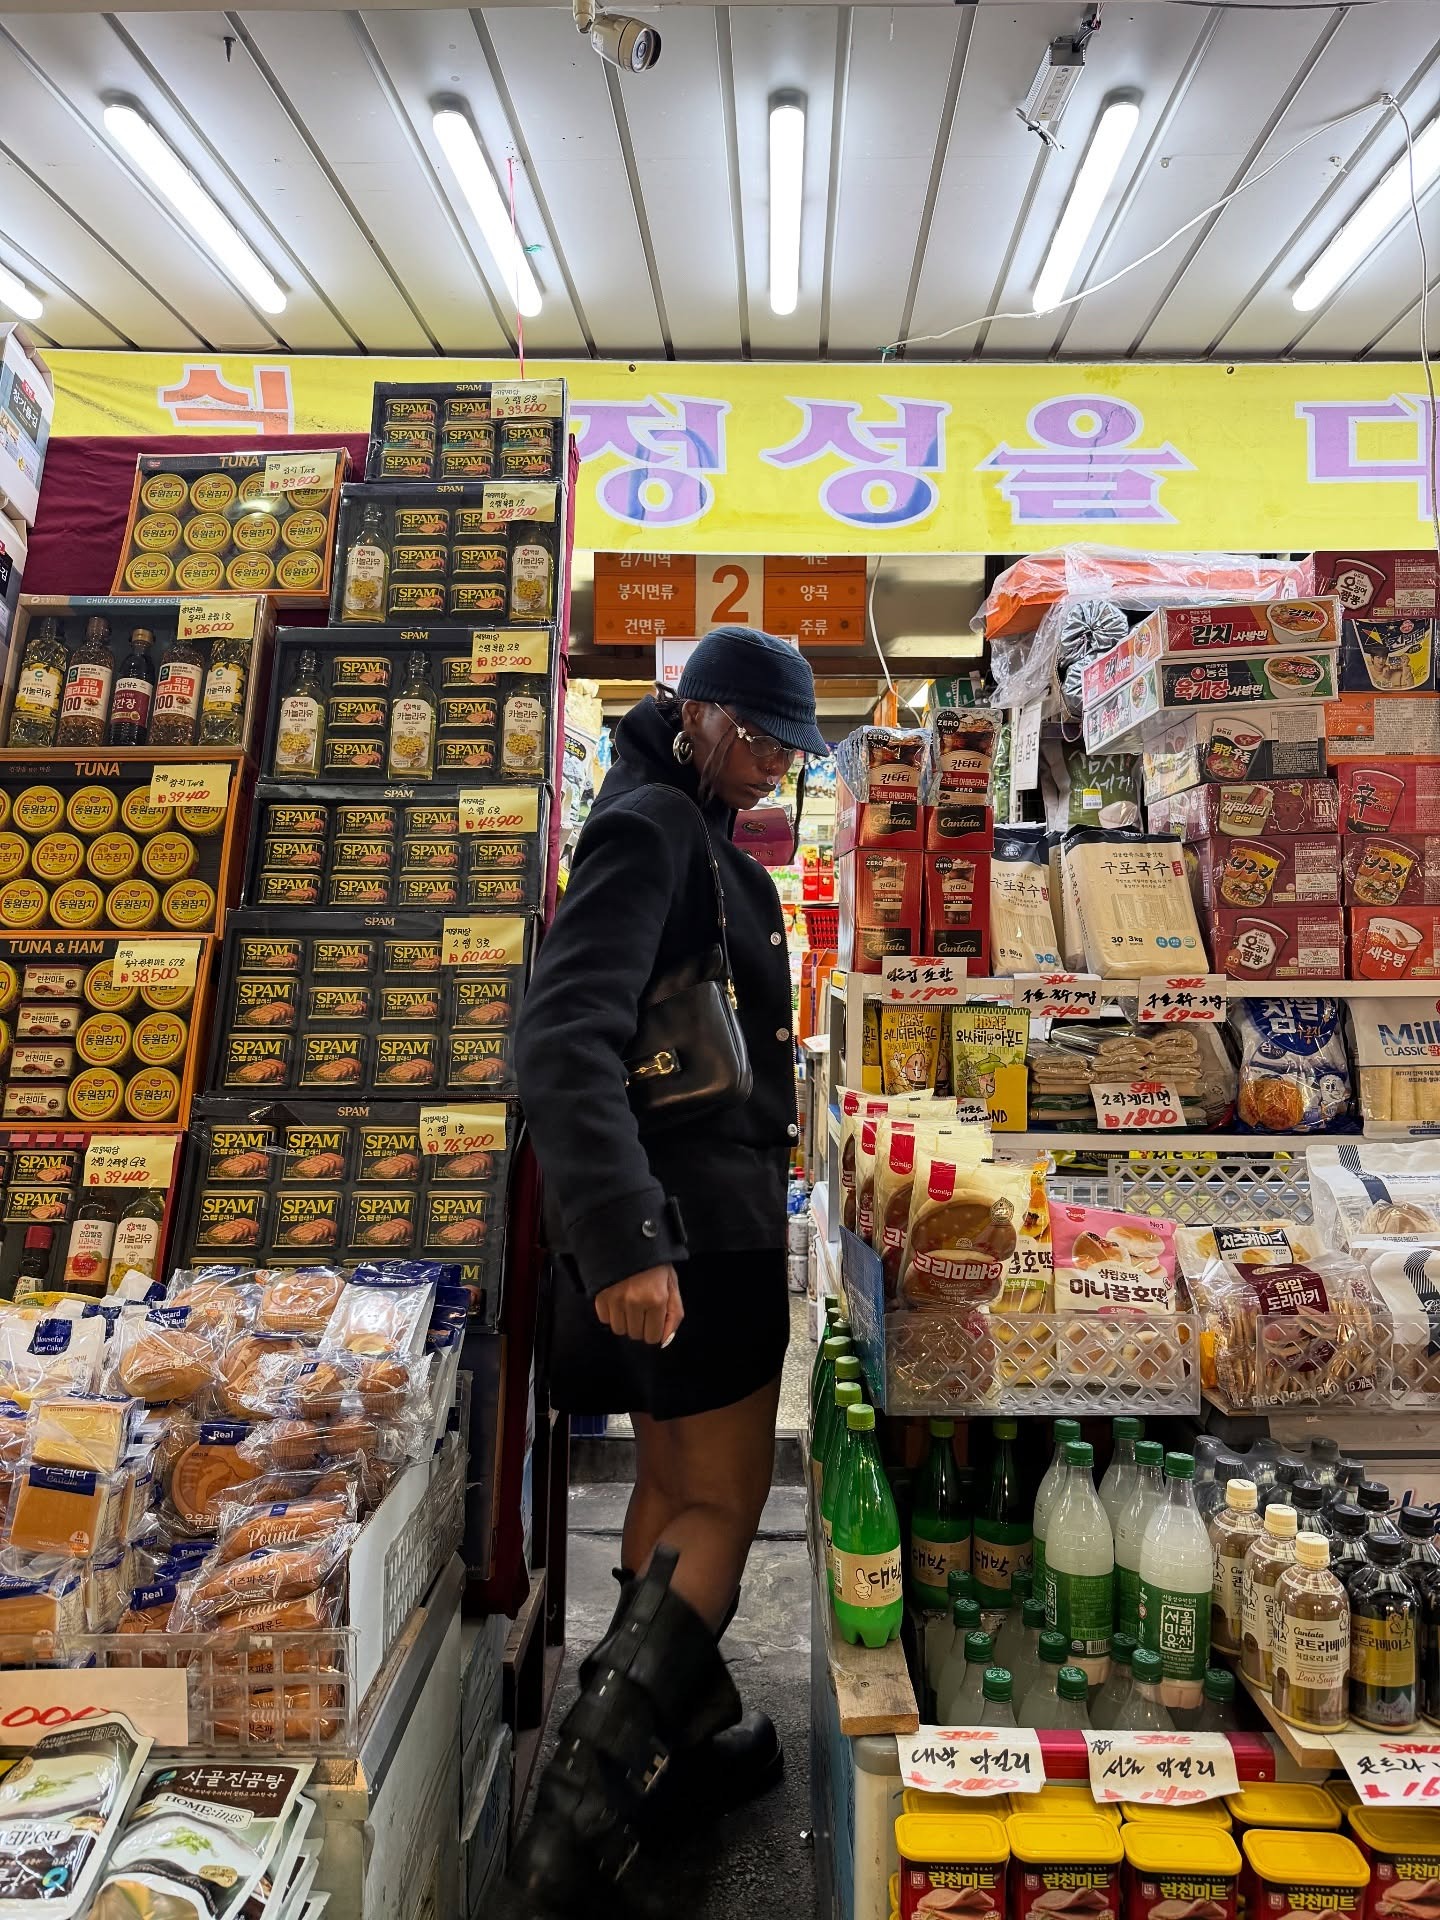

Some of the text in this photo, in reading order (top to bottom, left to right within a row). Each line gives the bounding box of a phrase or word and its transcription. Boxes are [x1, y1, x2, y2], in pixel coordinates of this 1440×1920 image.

[219, 455, 260, 468] TUNA
[617, 583, 674, 601] 봉지면류
[710, 564, 750, 623] 2
[800, 585, 829, 601] 양곡
[1189, 614, 1212, 624] 농심
[1288, 608, 1315, 618] 김치
[624, 618, 667, 635] 건면류
[800, 619, 829, 636] 주류
[1191, 624, 1269, 646] 김치 사발면
[1206, 668, 1229, 677] 농심
[82, 678, 98, 687] 요리
[174, 677, 190, 686] 요리
[1174, 679, 1263, 700] 육개장 사발면
[283, 708, 314, 718] 카놀라유
[396, 711, 428, 721] 카놀라유
[508, 709, 539, 719] 카놀라유
[937, 718, 960, 728] ZERO
[867, 733, 890, 742] ZERO
[1211, 742, 1251, 765] 튀김우동
[74, 762, 121, 777] TUNA
[951, 759, 983, 769] 칸타타
[169, 778, 186, 788] 참치
[880, 773, 912, 784] 칸타타
[1352, 783, 1380, 818] 辛
[21, 804, 56, 815] 동원참치
[74, 804, 110, 815] 동원참치
[1221, 801, 1267, 818] 짜파게티
[872, 814, 912, 827] Cantata
[940, 816, 981, 829] Cantata
[1234, 815, 1252, 824] 범벅
[39, 852, 76, 863] 고추참치
[94, 853, 131, 863] 고추참치
[150, 852, 186, 863] 고추참치
[866, 859, 884, 867] ZERO
[1101, 860, 1171, 877] 구포국수
[1230, 856, 1274, 879] 너구리
[1364, 855, 1408, 878] 너구리
[990, 877, 1040, 898] 구포국수
[9, 940, 104, 954] TUNA & HAM
[866, 940, 906, 952] Cantata
[1111, 936, 1124, 944] 30
[1128, 936, 1144, 944] 3kg
[1244, 935, 1270, 956] 오징어
[246, 944, 289, 957] SPAM
[317, 945, 359, 957] SPAM
[393, 946, 435, 958] SPAM
[938, 943, 977, 954] Cantata
[1242, 950, 1263, 965] 짬뽕
[1366, 946, 1407, 969] 새우탕
[37, 974, 65, 984] 런천미트
[922, 967, 954, 983] 포함
[240, 983, 290, 998] SPAM
[458, 983, 507, 998] SPAM
[239, 997, 255, 1005] 스팸
[316, 992, 358, 1005] SPAM
[386, 993, 428, 1006] SPAM
[458, 997, 474, 1005] 스팸
[31, 1015, 60, 1024] 런천미트
[898, 1013, 925, 1027] HBAF
[973, 1015, 1007, 1030] HBAF
[86, 1033, 123, 1046] 동원참치
[141, 1033, 179, 1045] 동원참치
[883, 1027, 939, 1042] 허니버터아몬드
[956, 1030, 1024, 1047] 와사비맛아몬드
[231, 1039, 283, 1055] SPAM
[307, 1039, 357, 1054] SPAM
[380, 1039, 429, 1055] SPAM
[452, 1039, 501, 1054] SPAM
[1384, 1046, 1428, 1057] CLASSIC
[230, 1054, 246, 1062] 스팸
[307, 1053, 323, 1061] 스팸
[379, 1054, 395, 1062] 스팸
[77, 1088, 116, 1101] 동원참치
[134, 1088, 173, 1101] 동원참치
[212, 1132, 265, 1149] SPAM
[288, 1133, 340, 1149] SPAM
[364, 1134, 416, 1150] SPAM
[18, 1155, 63, 1169] SPAM
[890, 1158, 912, 1170] samlip
[928, 1187, 952, 1197] samlip
[13, 1193, 58, 1206] SPAM
[202, 1197, 255, 1214] SPAM
[281, 1198, 334, 1214] SPAM
[359, 1198, 411, 1214] SPAM
[431, 1198, 482, 1214] SPAM
[135, 1223, 147, 1231] 백설
[118, 1233, 153, 1244] 카놀라유
[1221, 1231, 1287, 1249] 치즈케이크
[1098, 1268, 1140, 1283] 삼립호떡
[1275, 1279, 1303, 1294] 한입
[1069, 1278, 1170, 1311] 미니꿀호떡
[1267, 1289, 1320, 1311] 도라야키
[213, 1430, 234, 1439] Real
[248, 1524, 300, 1549] Pound
[141, 1589, 164, 1601] Real
[1164, 1611, 1193, 1626] 서울
[1164, 1624, 1192, 1637] 미래
[1293, 1628, 1324, 1638] Cantata
[1164, 1635, 1193, 1650] 유산
[1294, 1637, 1350, 1653] 콘트라베이스
[1295, 1670, 1341, 1684] Low Sugar
[911, 1747, 1031, 1774] 대박 막걸리
[1156, 1756, 1216, 1779] 막걸리
[181, 1768, 286, 1790] 사골진곰탕
[928, 1871, 996, 1890] 런천미트
[1042, 1872, 1110, 1890] 런천미트
[1160, 1882, 1229, 1901] 런천미트
[1287, 1892, 1357, 1912] 런천미트
